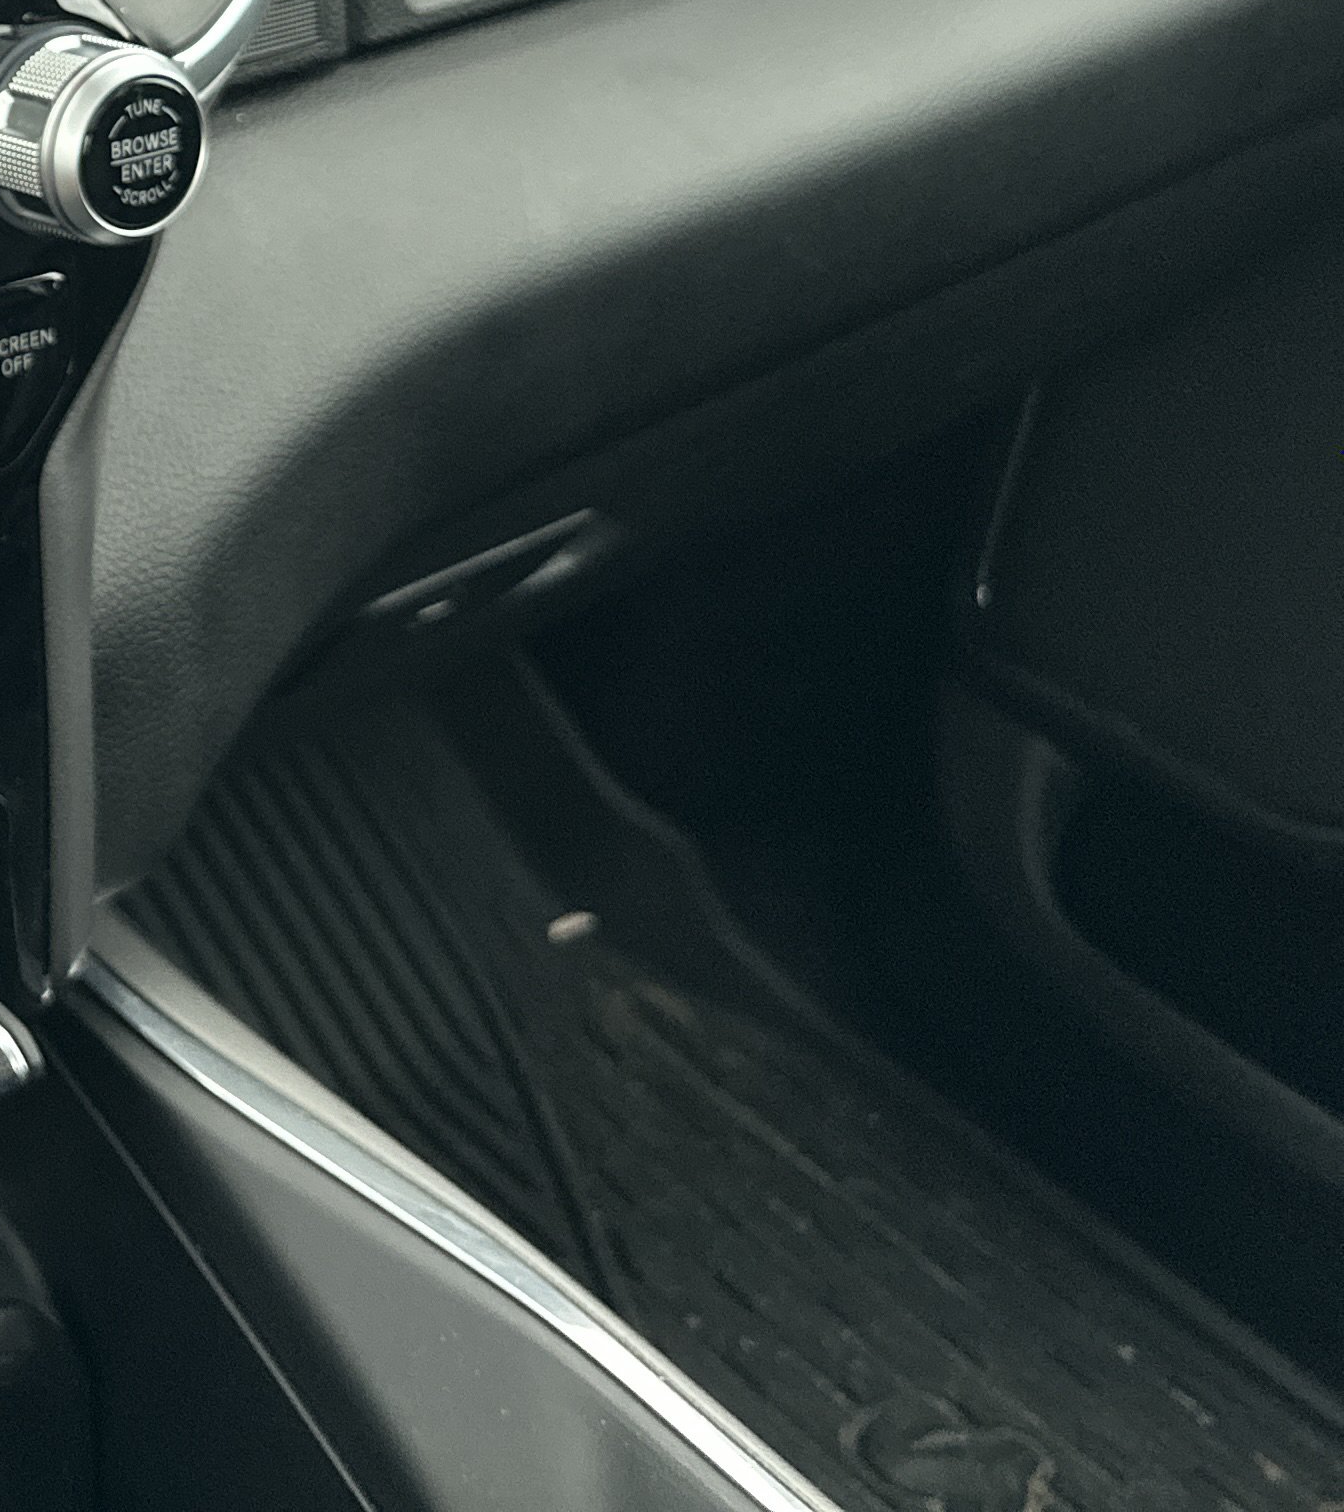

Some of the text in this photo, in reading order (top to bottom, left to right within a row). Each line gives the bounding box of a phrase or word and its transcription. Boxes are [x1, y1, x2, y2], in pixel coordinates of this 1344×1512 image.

[124, 99, 164, 122] TUNE
[111, 126, 179, 159] BROWSE
[121, 153, 175, 182] ENTER
[119, 180, 174, 208] SCROLL
[1, 352, 35, 377] OFF
